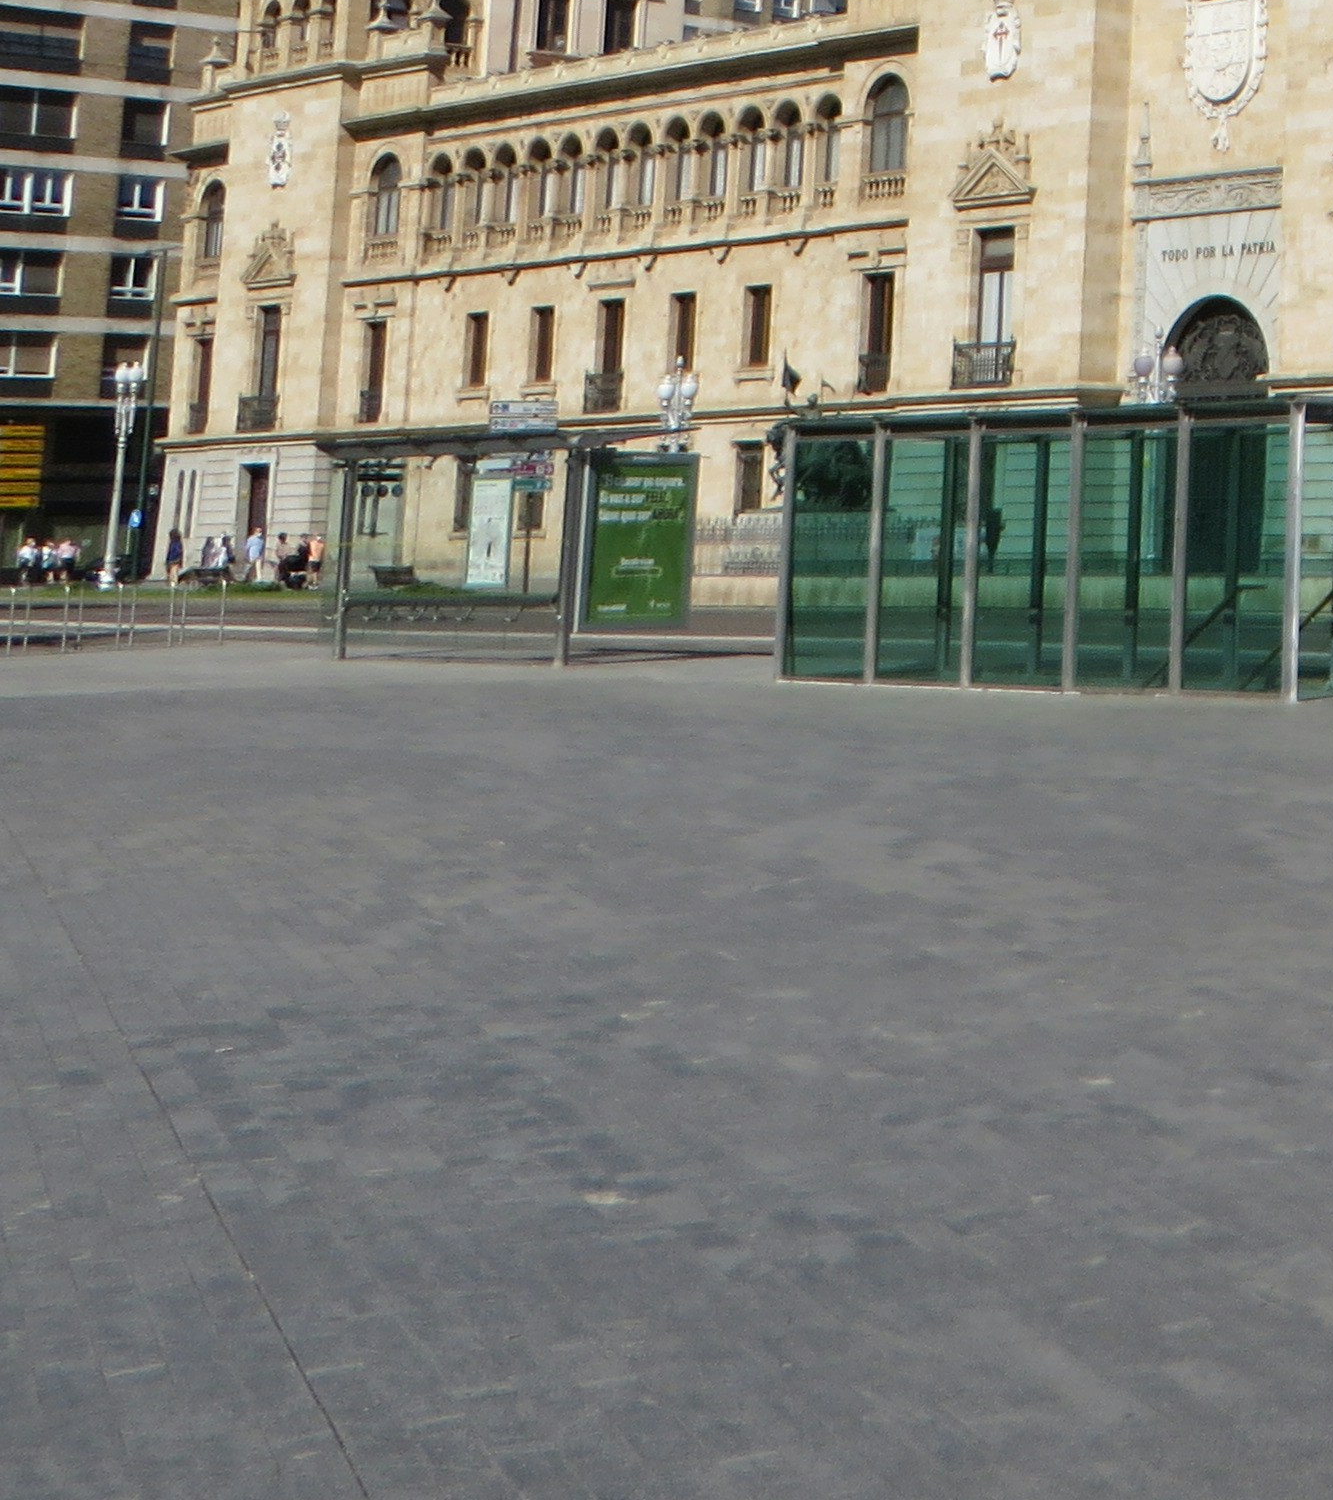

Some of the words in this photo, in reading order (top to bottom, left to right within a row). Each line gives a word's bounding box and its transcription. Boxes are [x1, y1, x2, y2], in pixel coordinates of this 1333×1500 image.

[1161, 249, 1189, 262] TODO
[1195, 246, 1216, 259] POR
[1221, 245, 1235, 257] LA
[1241, 241, 1276, 256] PATRIA
